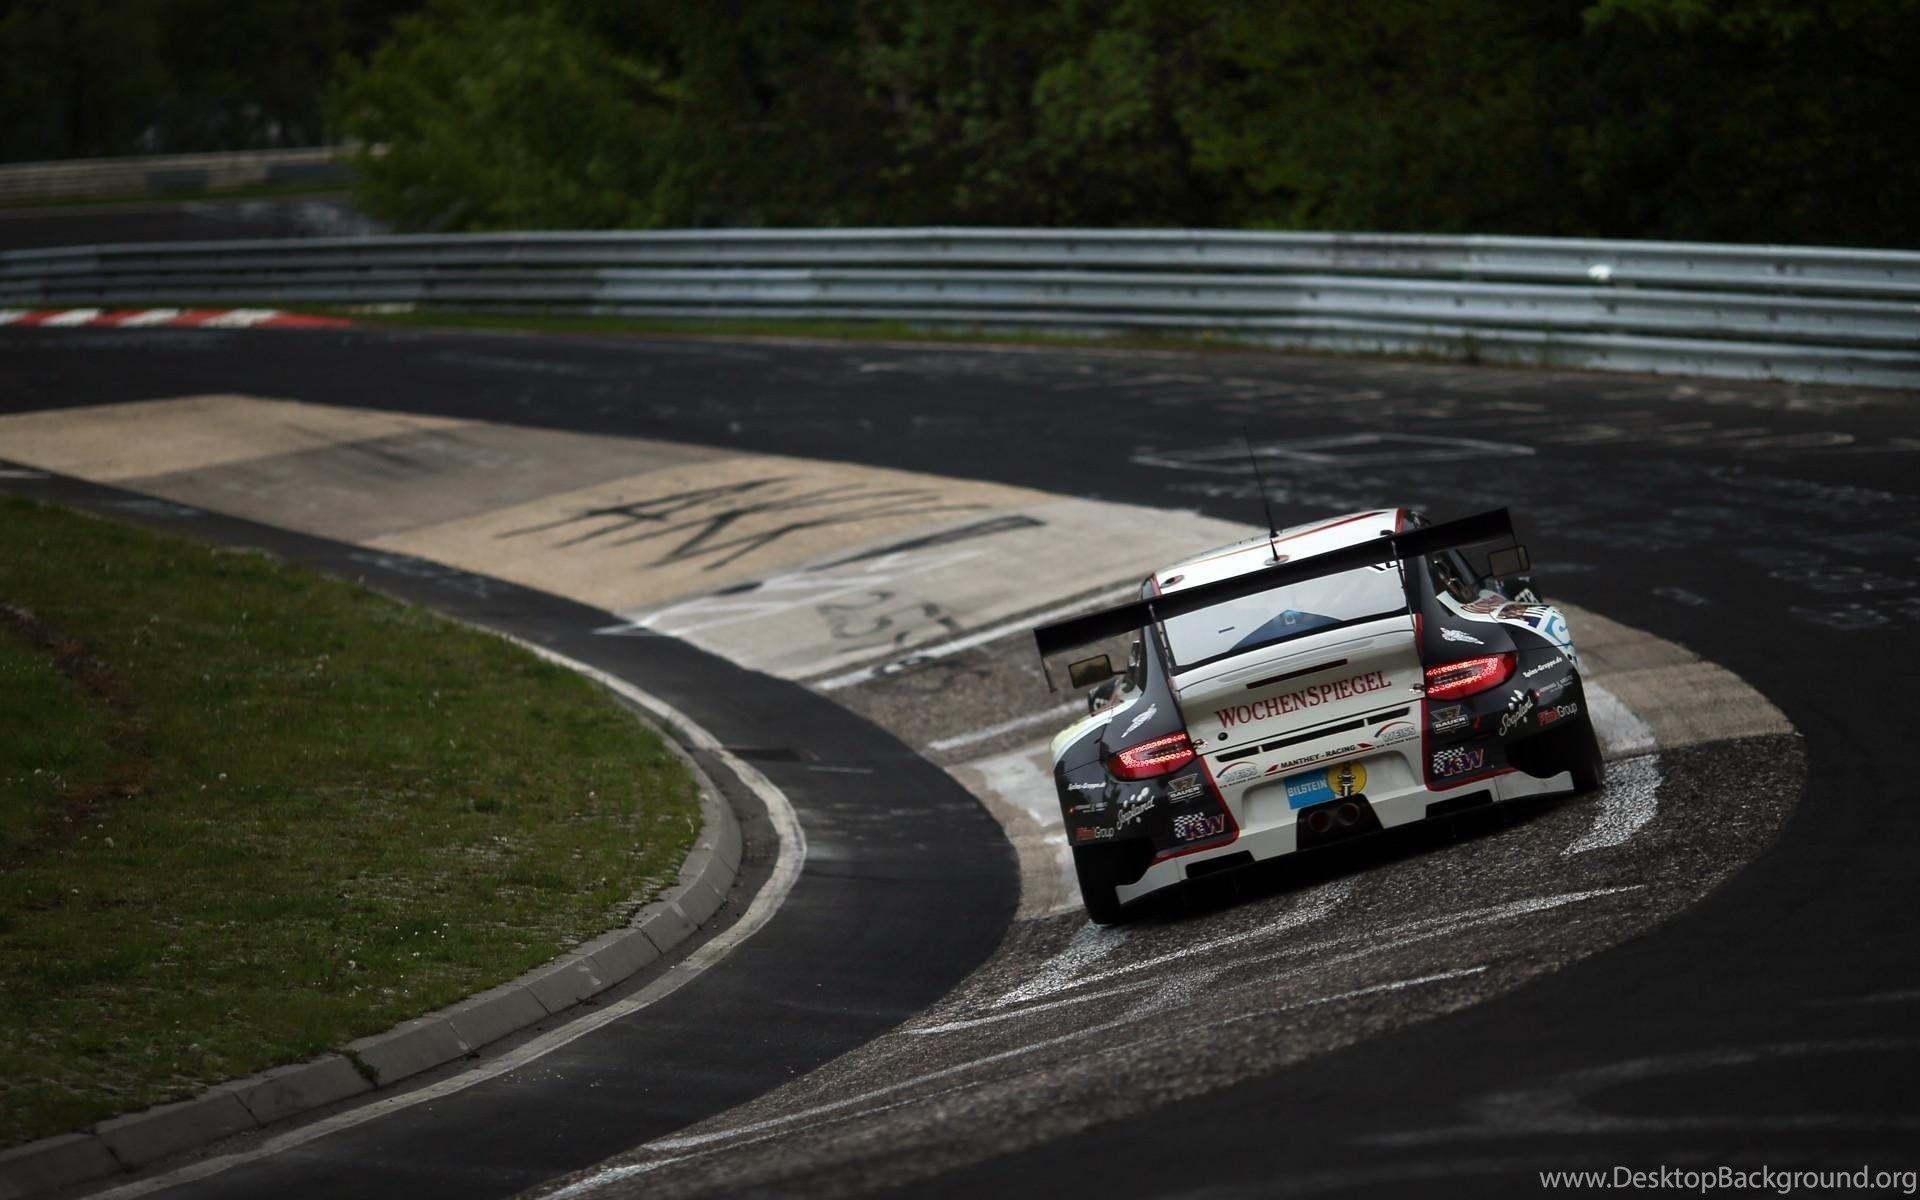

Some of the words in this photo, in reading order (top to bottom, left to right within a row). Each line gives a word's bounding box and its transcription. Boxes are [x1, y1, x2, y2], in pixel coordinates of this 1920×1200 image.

[1215, 671, 1392, 729] WOCHENSPIEGEL
[1434, 716, 1466, 729] BAUER
[1287, 779, 1328, 798] BILSTEIN
